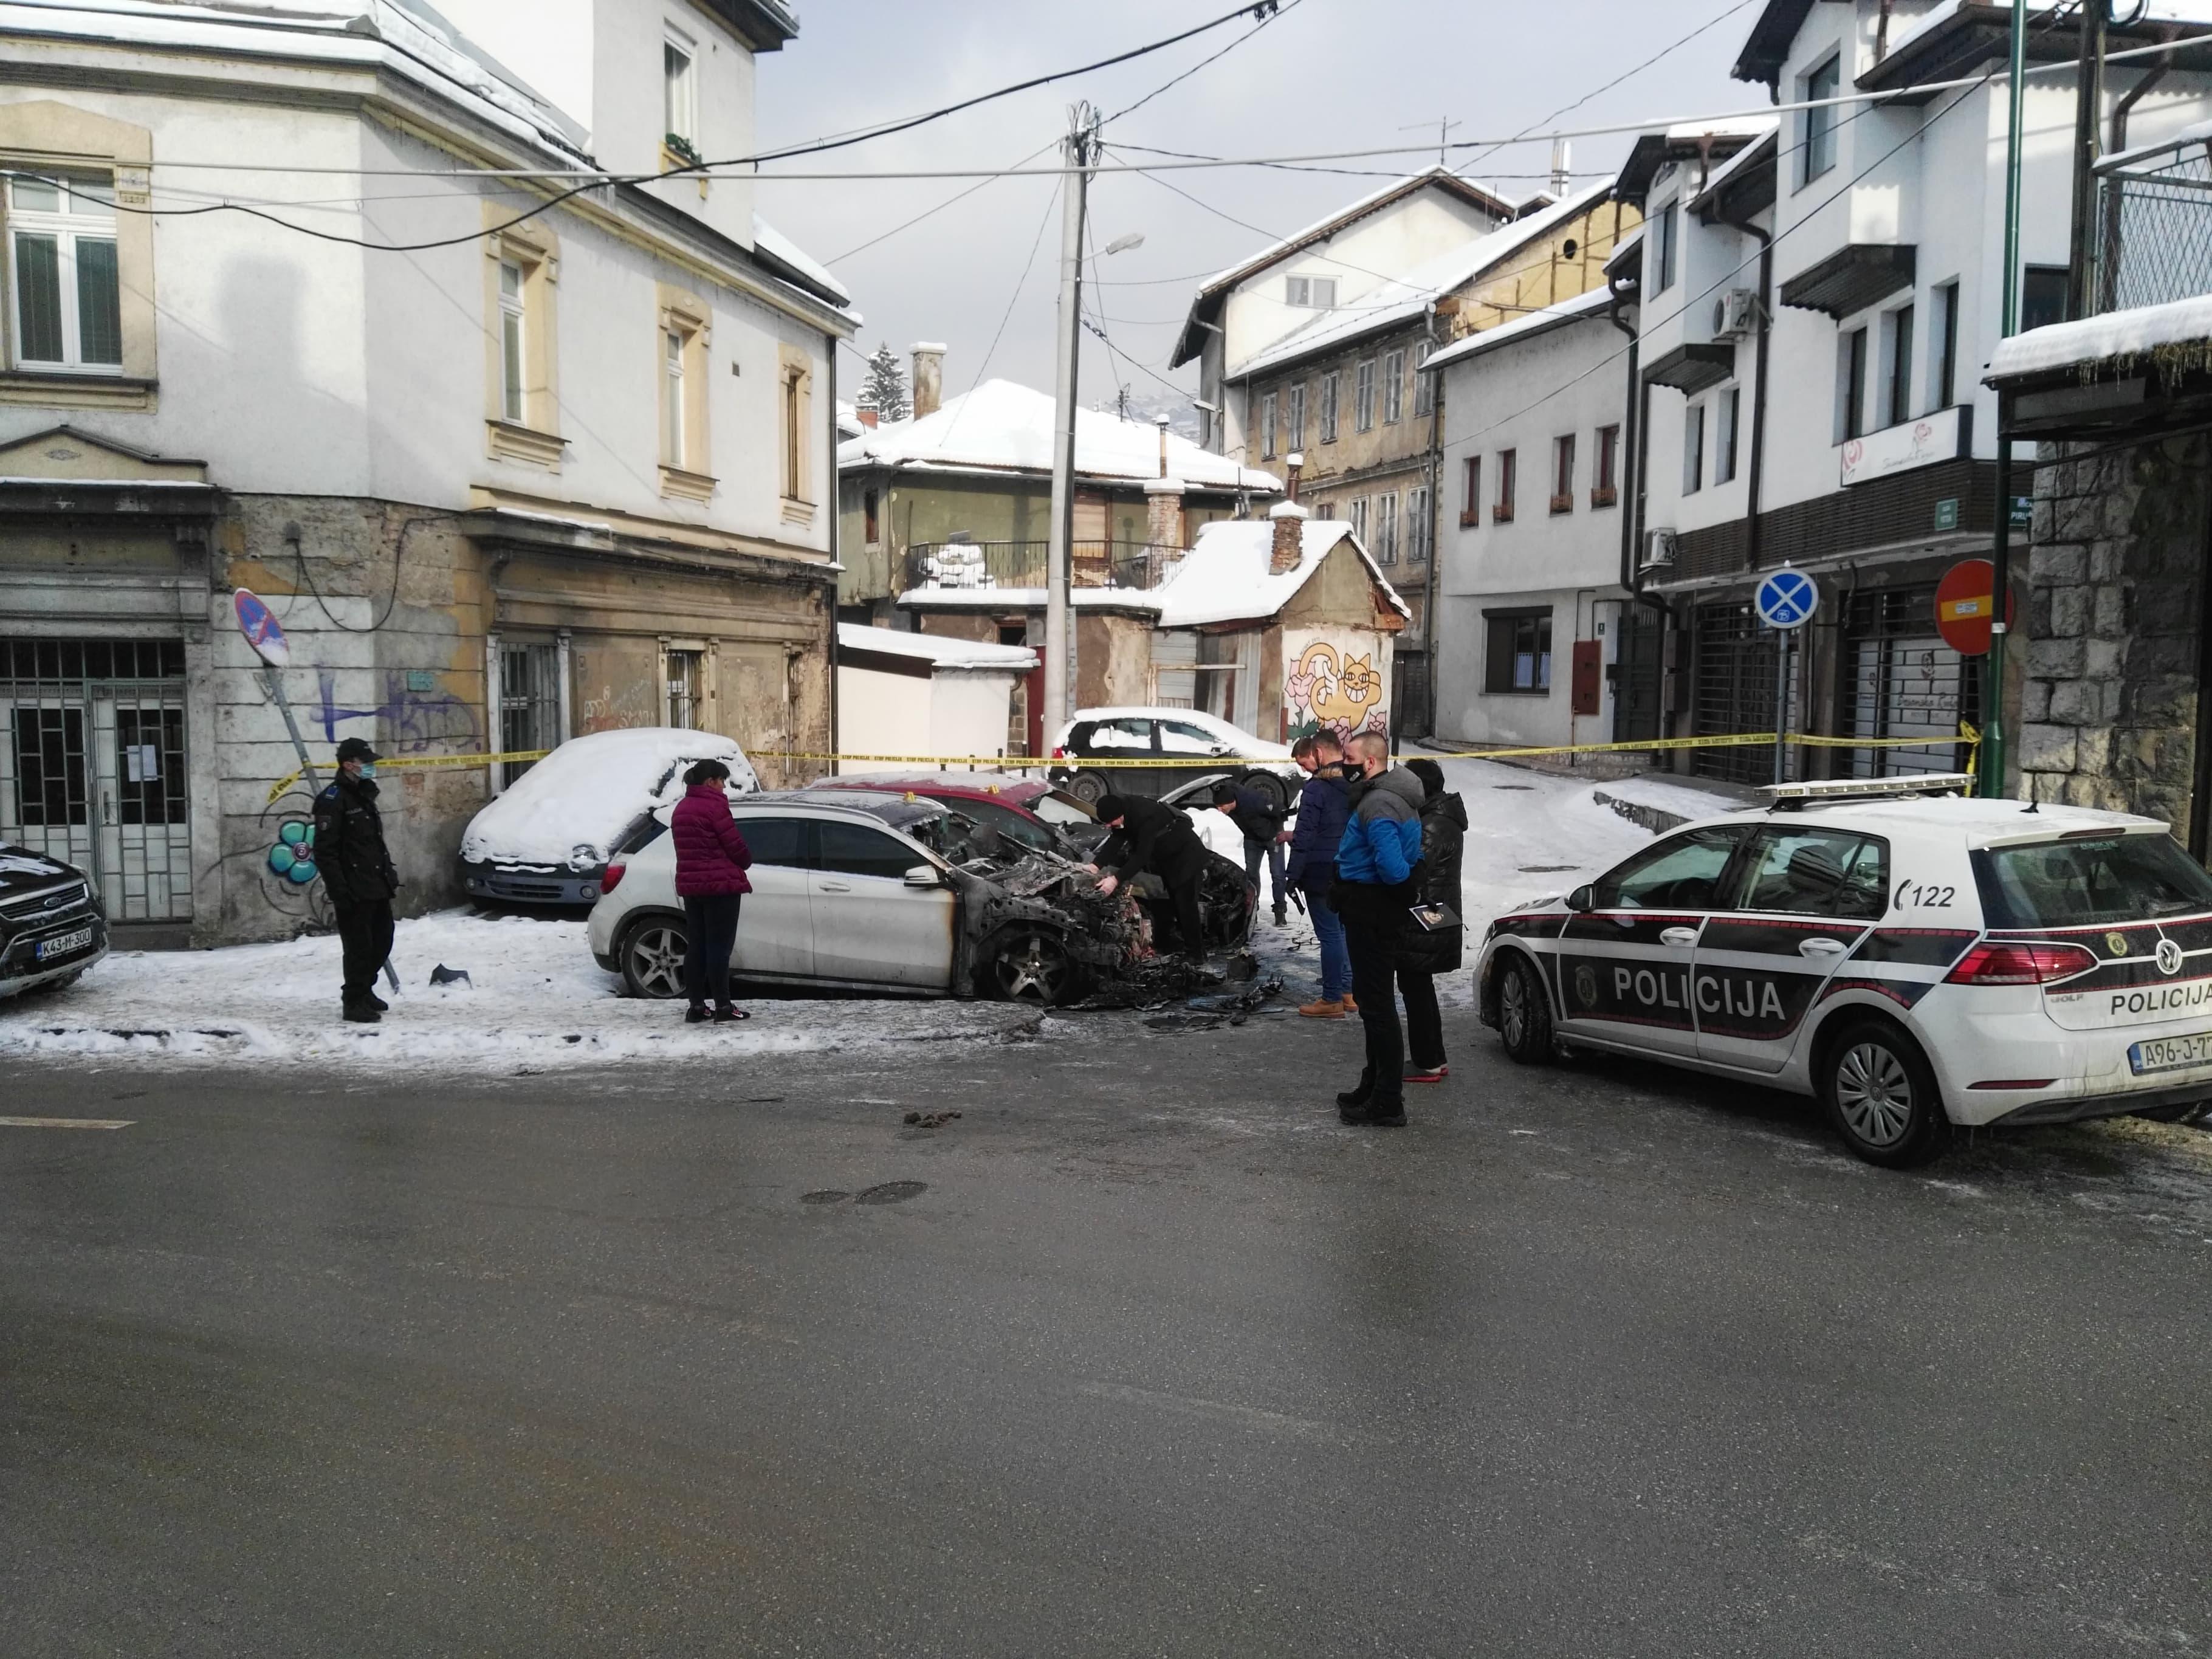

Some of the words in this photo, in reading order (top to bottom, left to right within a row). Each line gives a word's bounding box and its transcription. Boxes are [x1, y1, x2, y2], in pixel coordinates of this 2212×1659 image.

[1912, 886, 1955, 907] 122
[43, 930, 90, 955] K43-M-300
[1615, 967, 1786, 1020] POLICIJA
